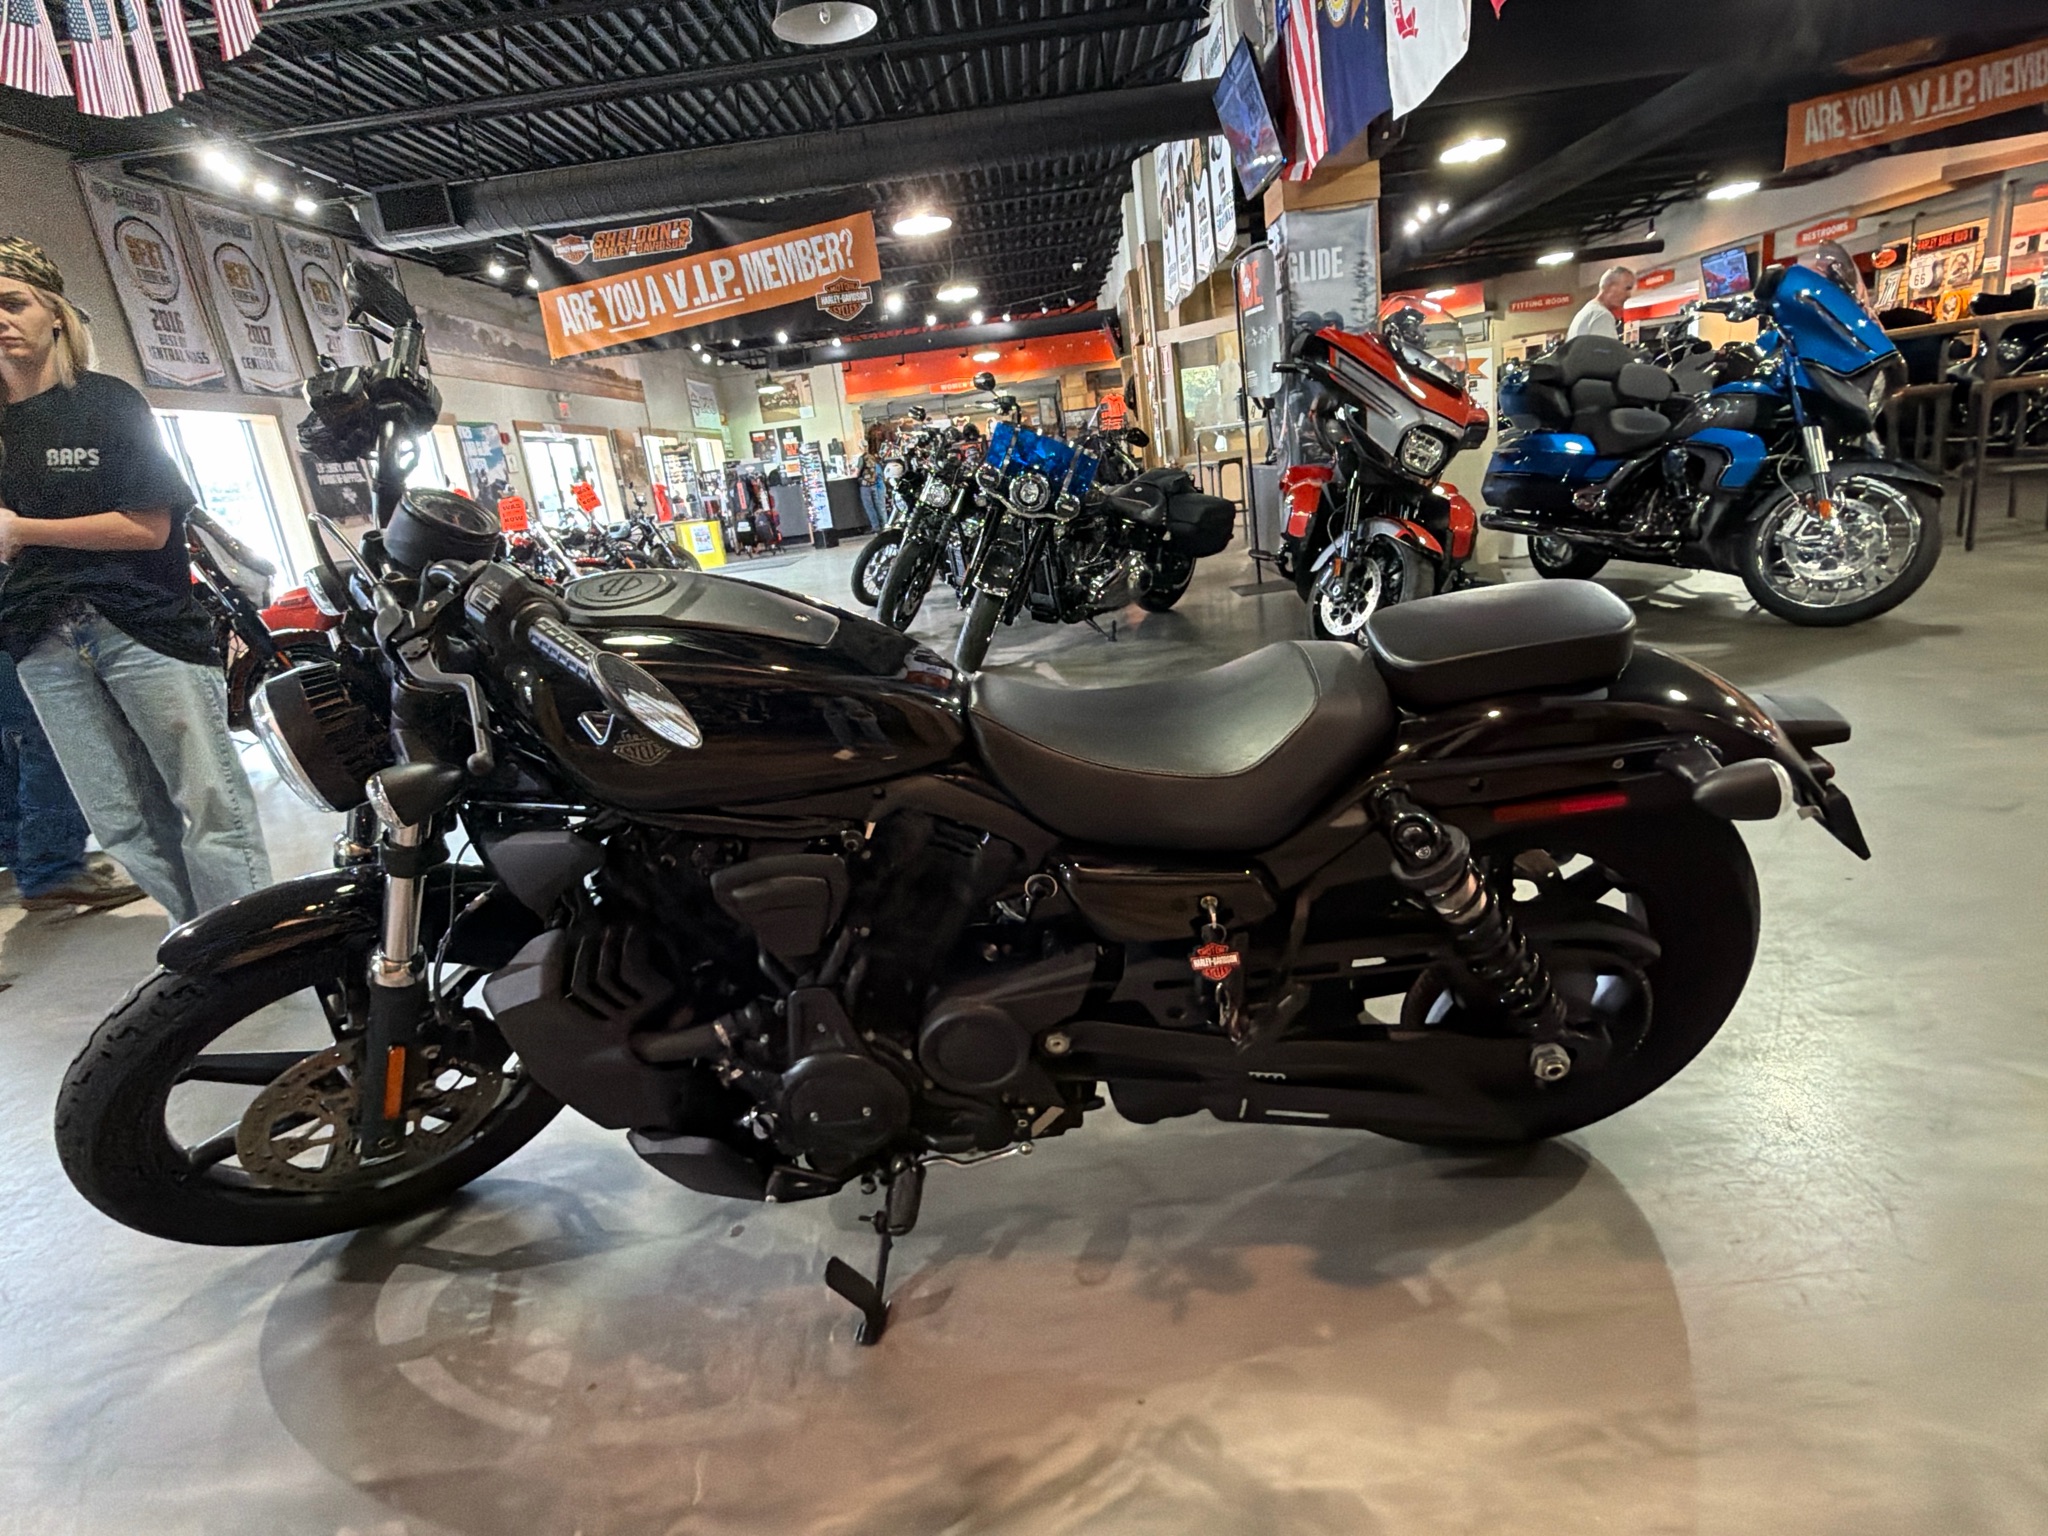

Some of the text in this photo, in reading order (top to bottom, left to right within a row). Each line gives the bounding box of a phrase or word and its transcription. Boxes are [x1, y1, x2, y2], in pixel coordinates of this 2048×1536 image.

[1804, 100, 1845, 146] ARE
[1847, 89, 1885, 134] YOU
[1889, 86, 1904, 125] A
[1907, 69, 1976, 118] V.I.P.
[593, 219, 691, 250] SHELDON'S
[1802, 220, 1848, 242] RESTROOMS
[594, 239, 687, 260] HARLEY-DAVIDSON
[1288, 246, 1344, 284] GLIDE
[556, 227, 855, 337] ARE YOU A V.I.P. MEMBER?
[1914, 273, 1926, 286] 66
[820, 291, 867, 306] HARLEY-DAVIDSON
[1511, 296, 1569, 311] FITTING ROOM
[830, 303, 858, 317] CYCLES
[150, 308, 185, 334] 2016
[244, 323, 272, 346] 2017
[46, 447, 100, 466] BAPS
[502, 503, 522, 511] WAS
[504, 515, 524, 523] NOW
[1193, 954, 1238, 968] HARLEY-DAVIDSON
